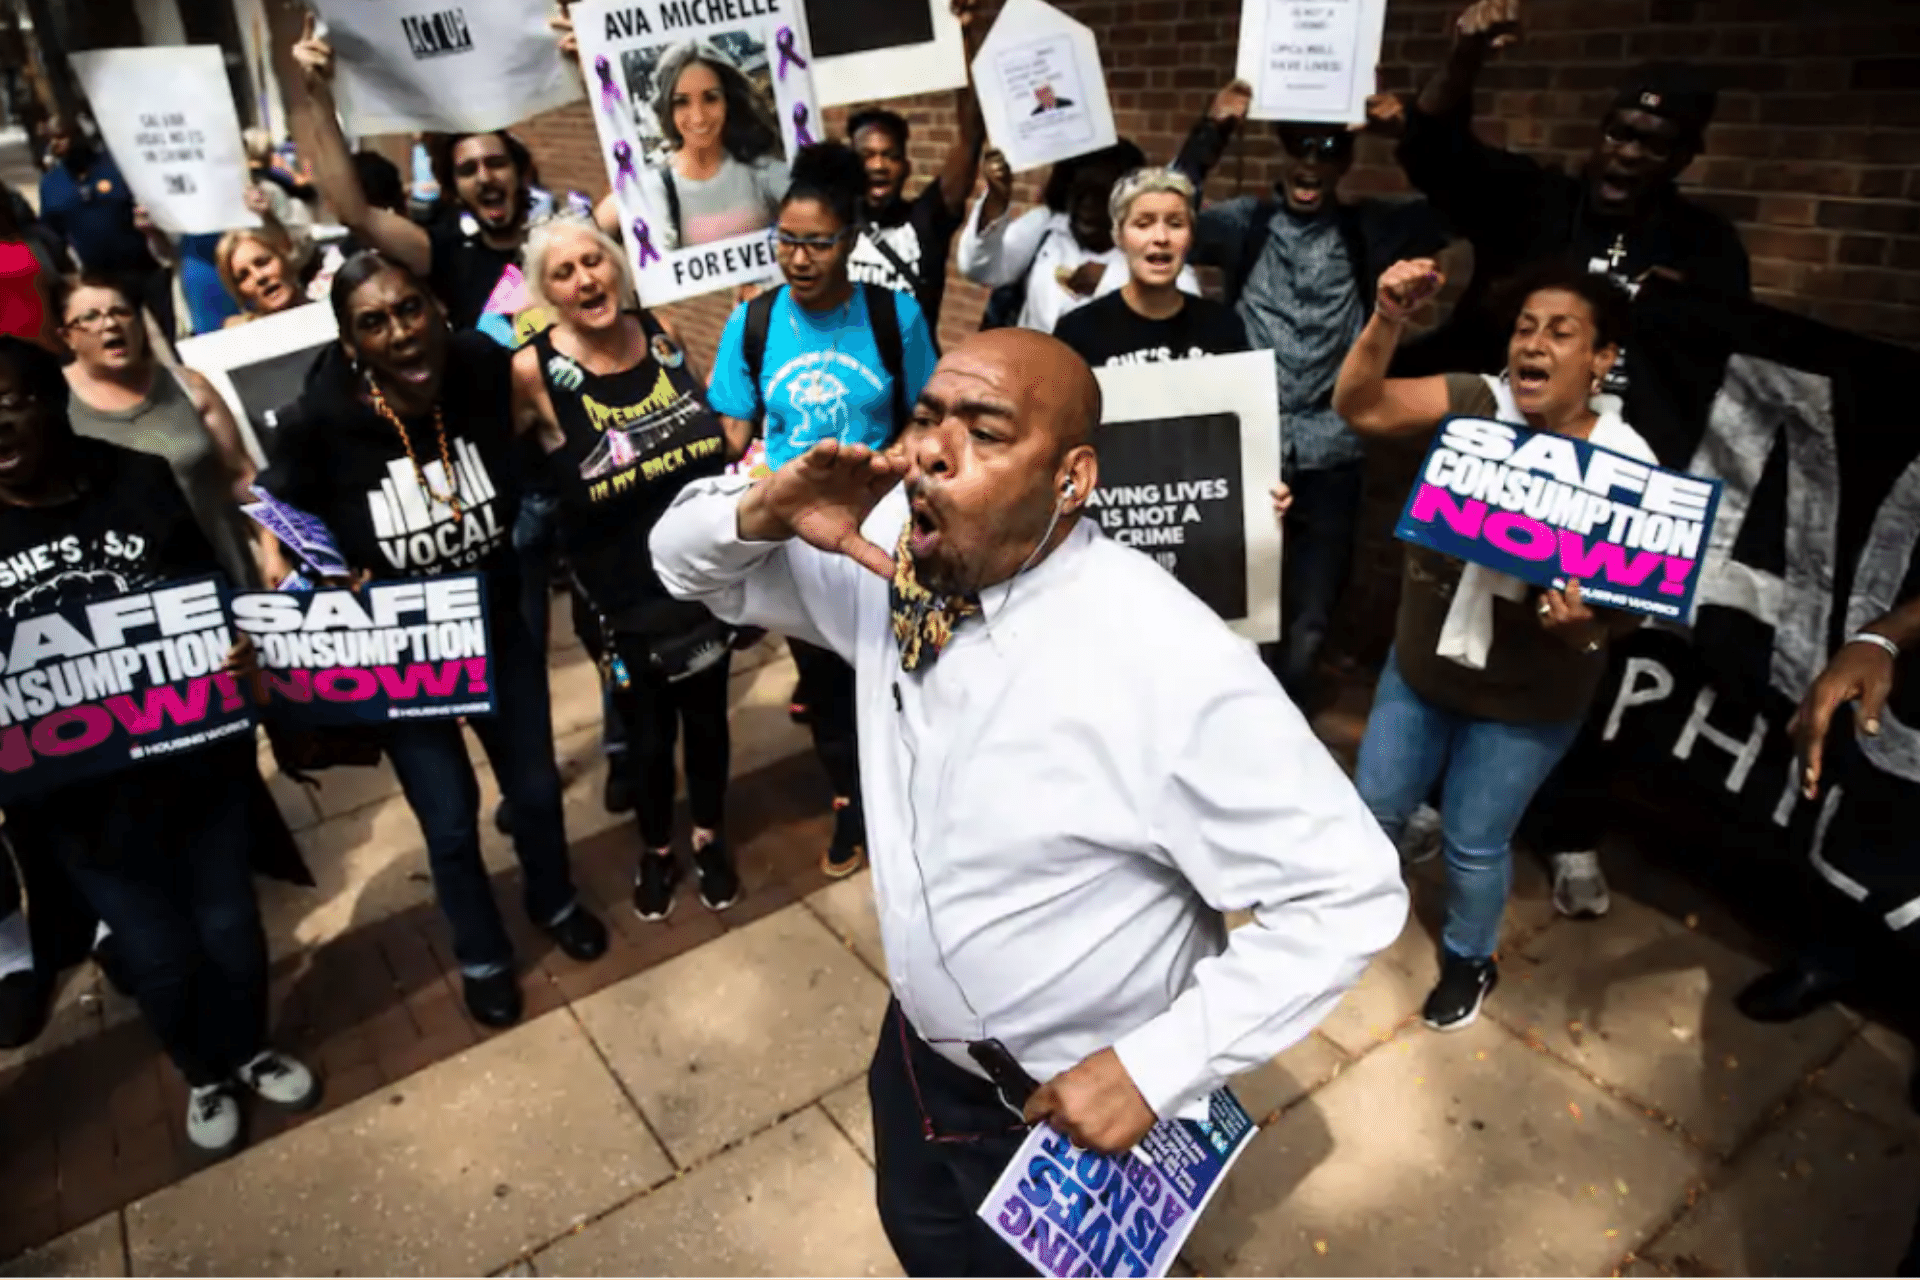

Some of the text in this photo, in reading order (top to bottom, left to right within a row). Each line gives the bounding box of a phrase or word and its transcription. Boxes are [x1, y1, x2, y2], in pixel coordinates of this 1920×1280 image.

[605, 0, 780, 41] AVA MICHELLE
[589, 480, 609, 502] IN
[612, 468, 637, 493] MY
[640, 447, 686, 480] BACK
[1085, 478, 1229, 507] AVING LIVES
[1441, 418, 1712, 521] SAFE
[1101, 503, 1202, 527] IS NOT A
[1425, 448, 1703, 559] CONSUMPTION
[378, 503, 504, 569] VOCAL
[1114, 526, 1184, 546] CRIME
[1411, 483, 1696, 596] NOW!
[0, 580, 226, 675] AFE
[231, 577, 481, 632] SAFE
[0, 626, 232, 727] NSUMPTION
